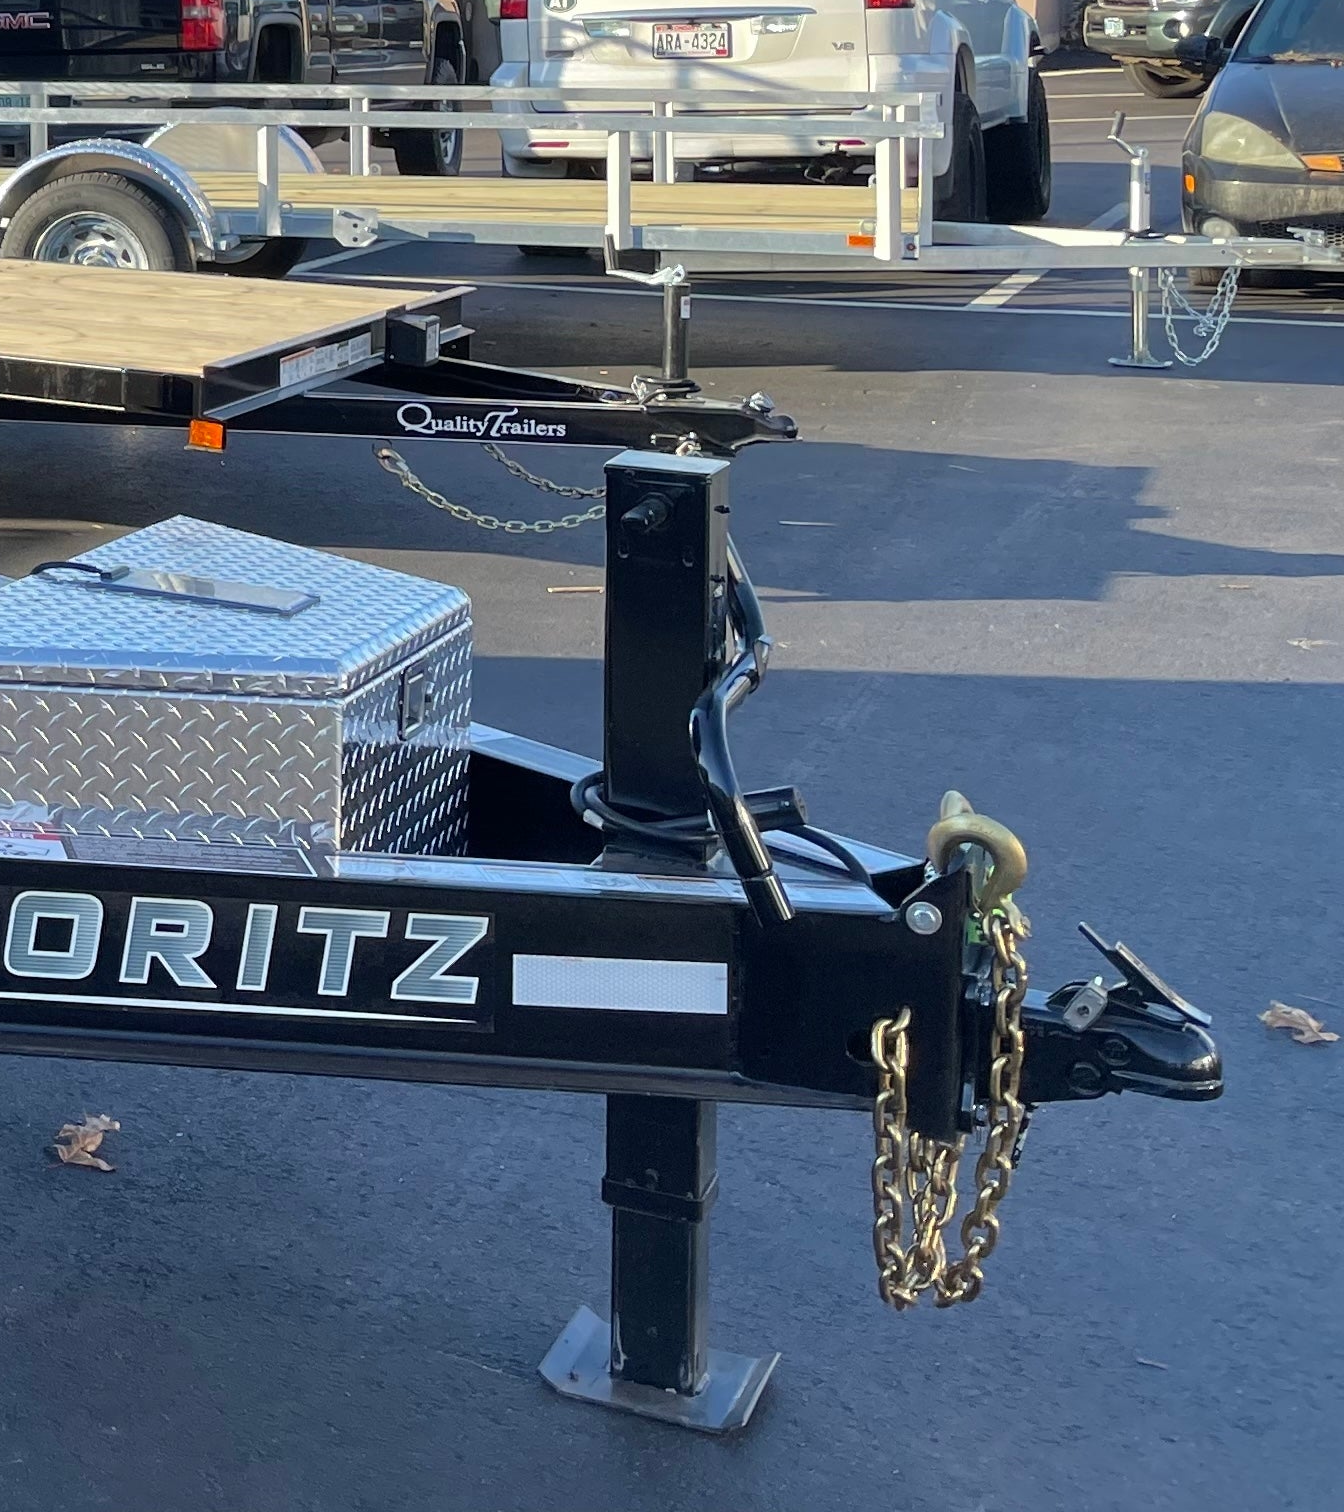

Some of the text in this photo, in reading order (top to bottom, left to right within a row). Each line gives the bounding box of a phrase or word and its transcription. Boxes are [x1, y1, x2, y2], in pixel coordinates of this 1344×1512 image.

[656, 32, 726, 51] ARA-4324
[396, 402, 567, 438] Quality Trailers
